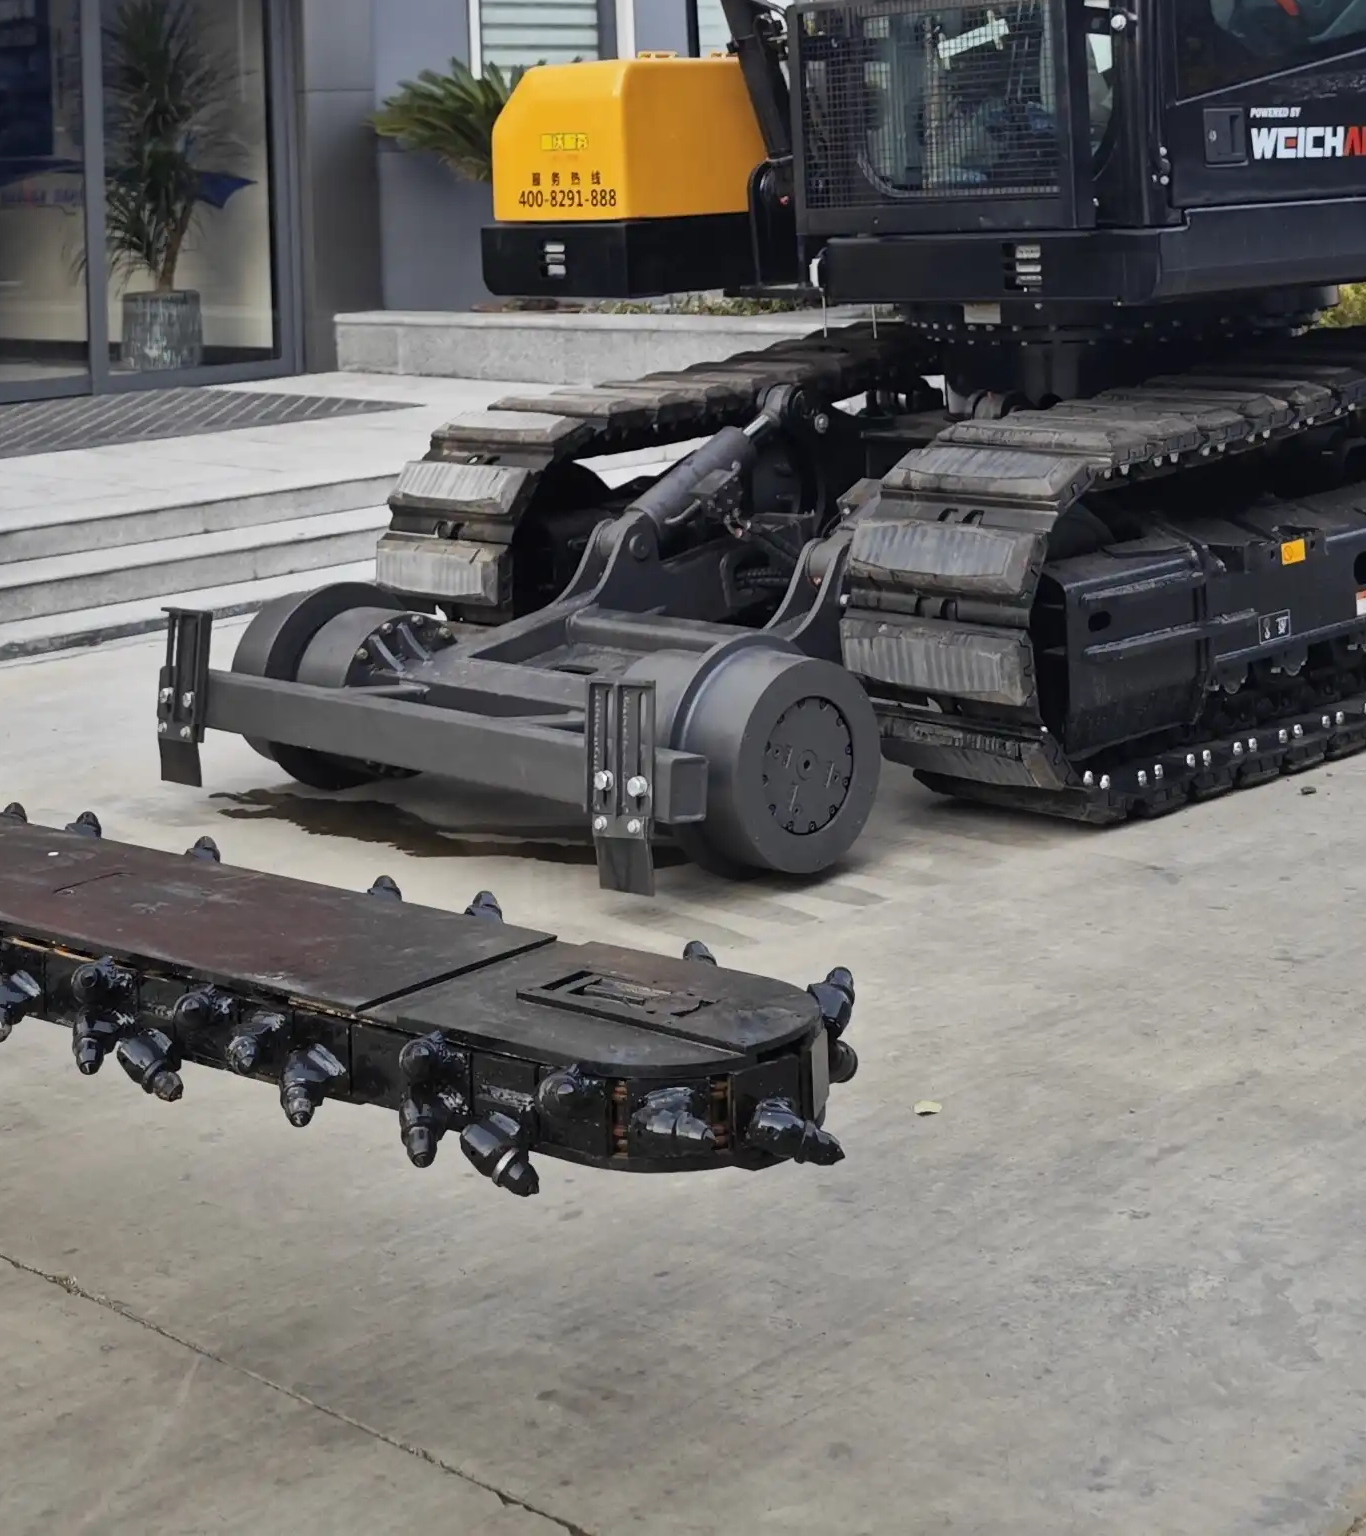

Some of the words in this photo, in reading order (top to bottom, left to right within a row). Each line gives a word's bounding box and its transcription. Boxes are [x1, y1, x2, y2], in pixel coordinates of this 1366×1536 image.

[1249, 107, 1288, 119] POWERED
[1289, 107, 1302, 118] BY
[518, 189, 617, 207] 400-8291-888
